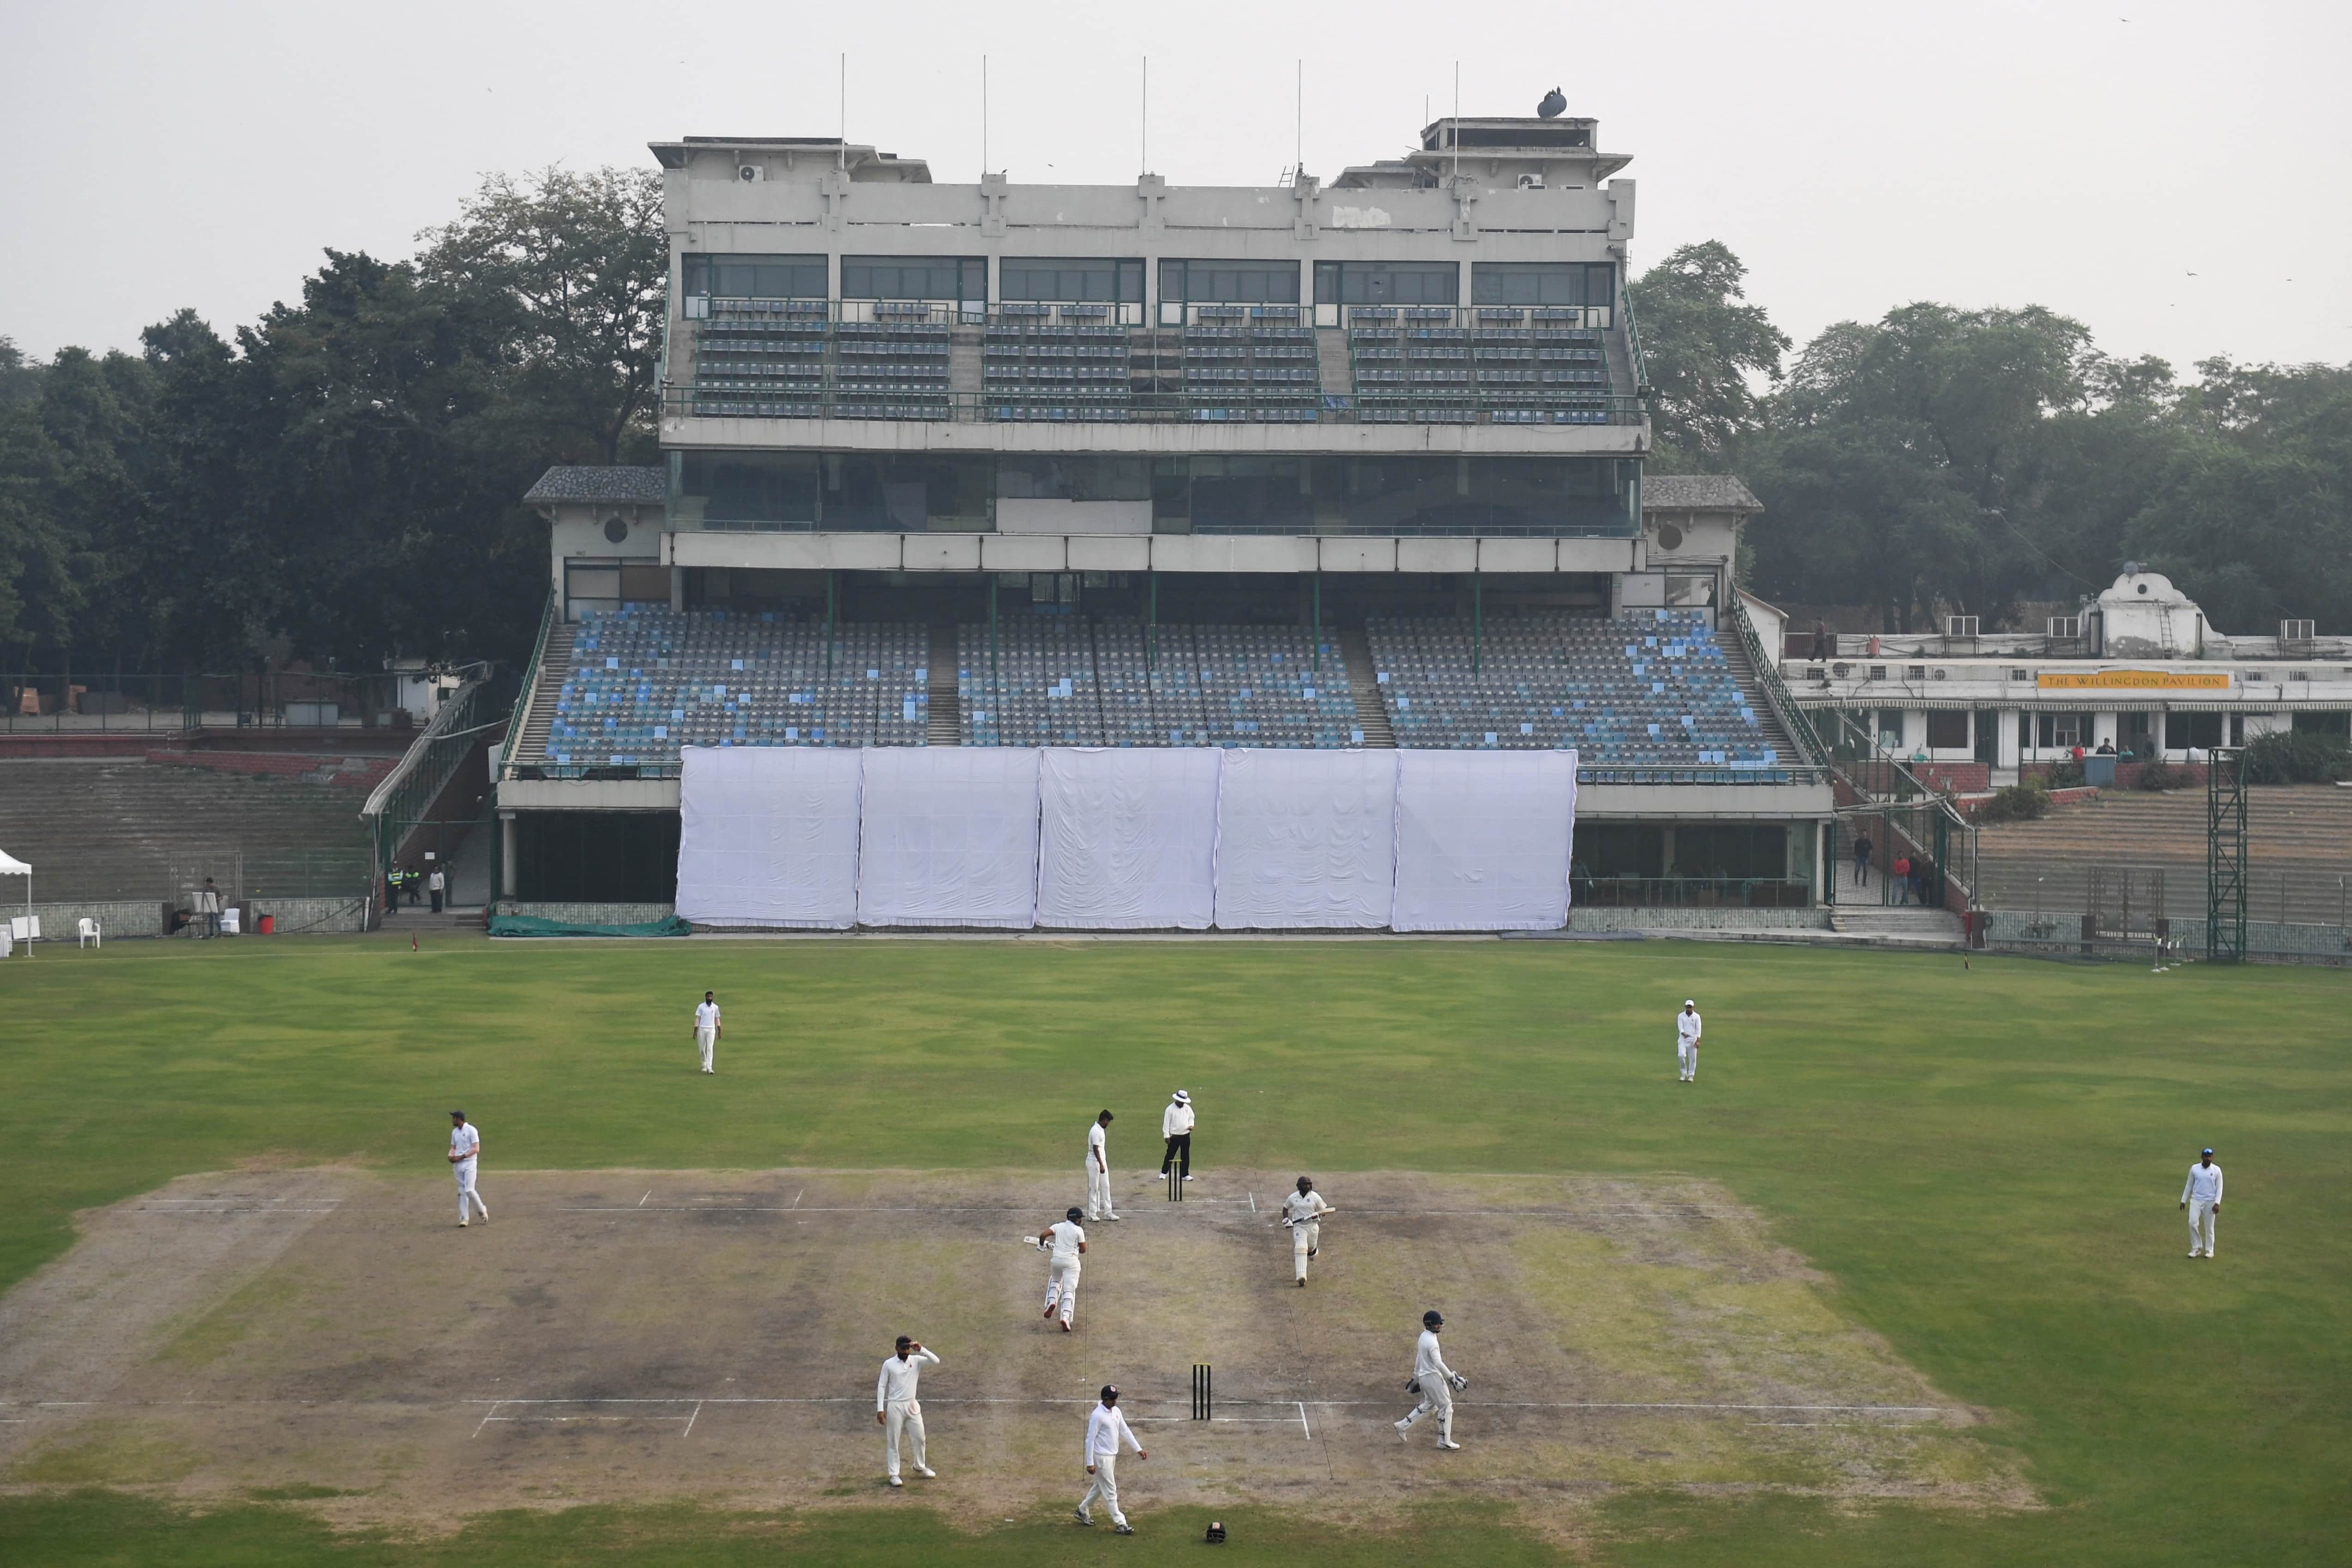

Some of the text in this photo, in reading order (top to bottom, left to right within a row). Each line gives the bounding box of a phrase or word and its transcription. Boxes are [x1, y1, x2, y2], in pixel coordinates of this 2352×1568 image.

[2048, 677, 2219, 685] THE WILLINGDON PAVILION
